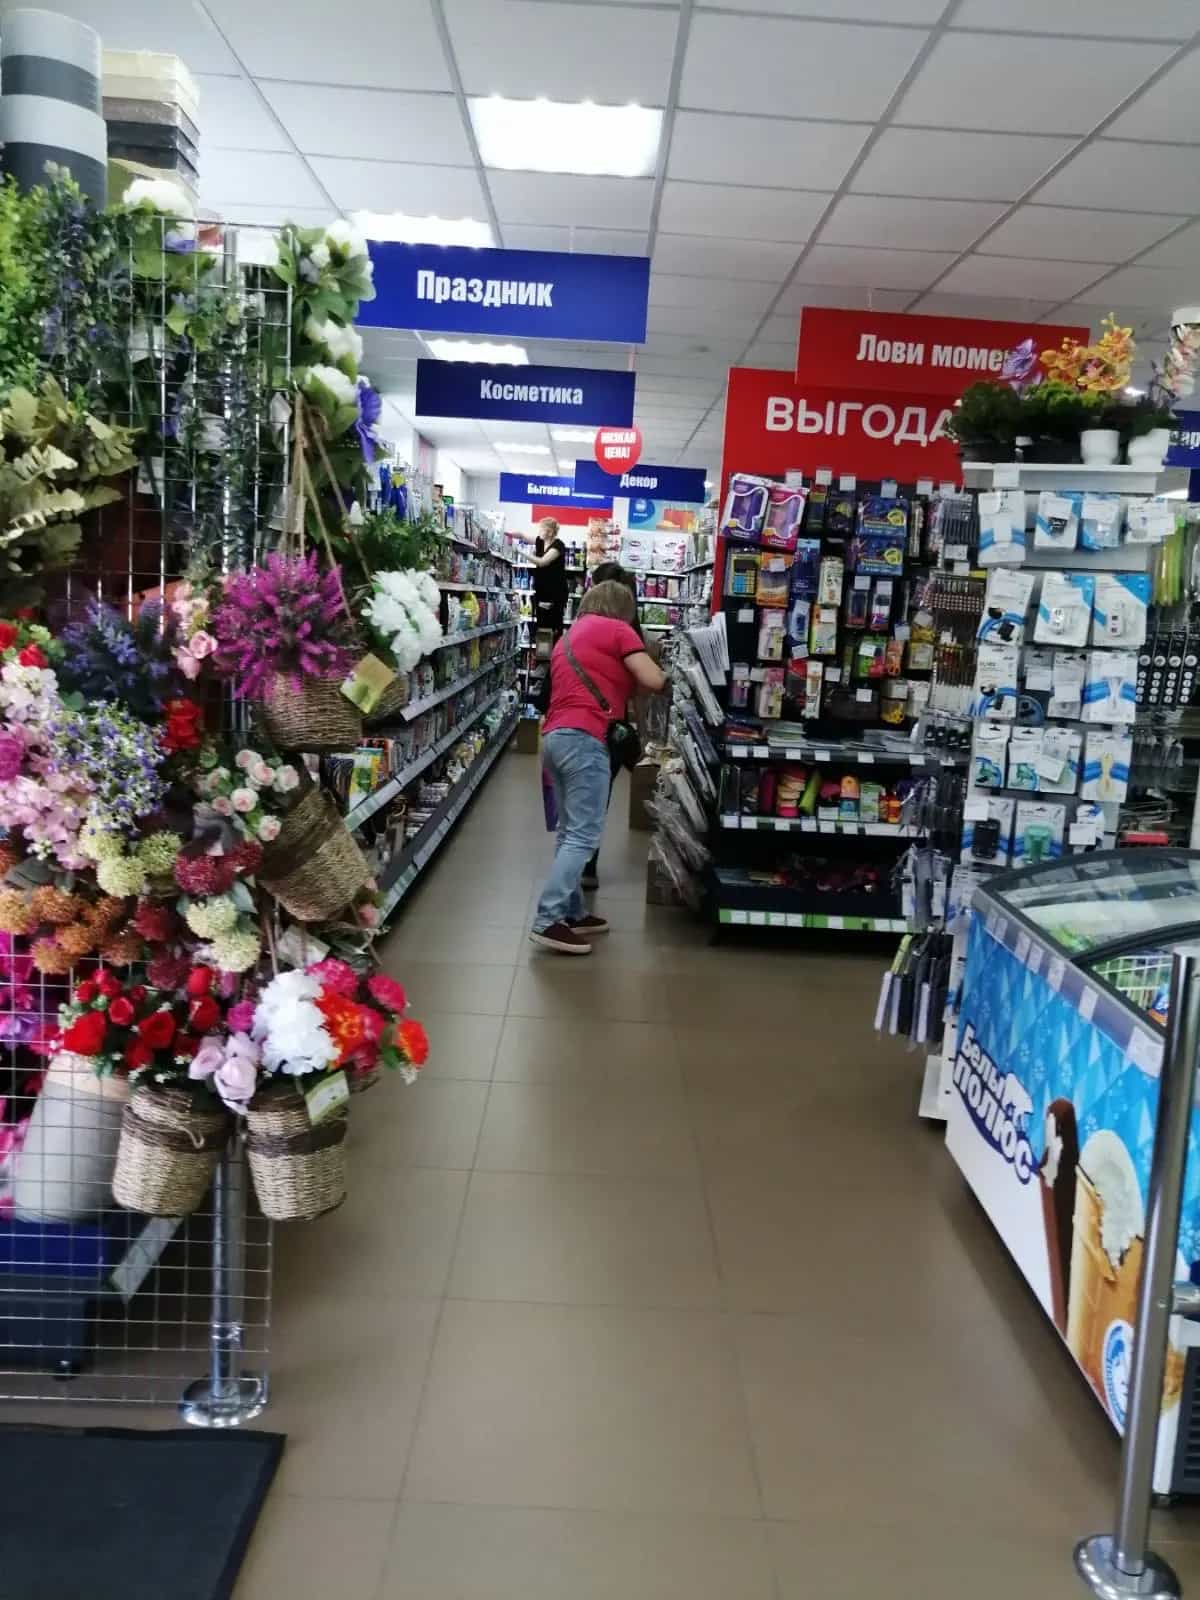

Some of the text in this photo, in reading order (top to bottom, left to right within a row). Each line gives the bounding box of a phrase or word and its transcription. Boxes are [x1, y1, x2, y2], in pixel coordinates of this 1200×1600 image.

[416, 270, 554, 307] Праздник
[856, 334, 1009, 371] Лови моме
[480, 379, 583, 405] Косметика
[765, 397, 960, 447] ВЫГОДА
[527, 482, 570, 496] Бытовая
[620, 473, 658, 489] Декор
